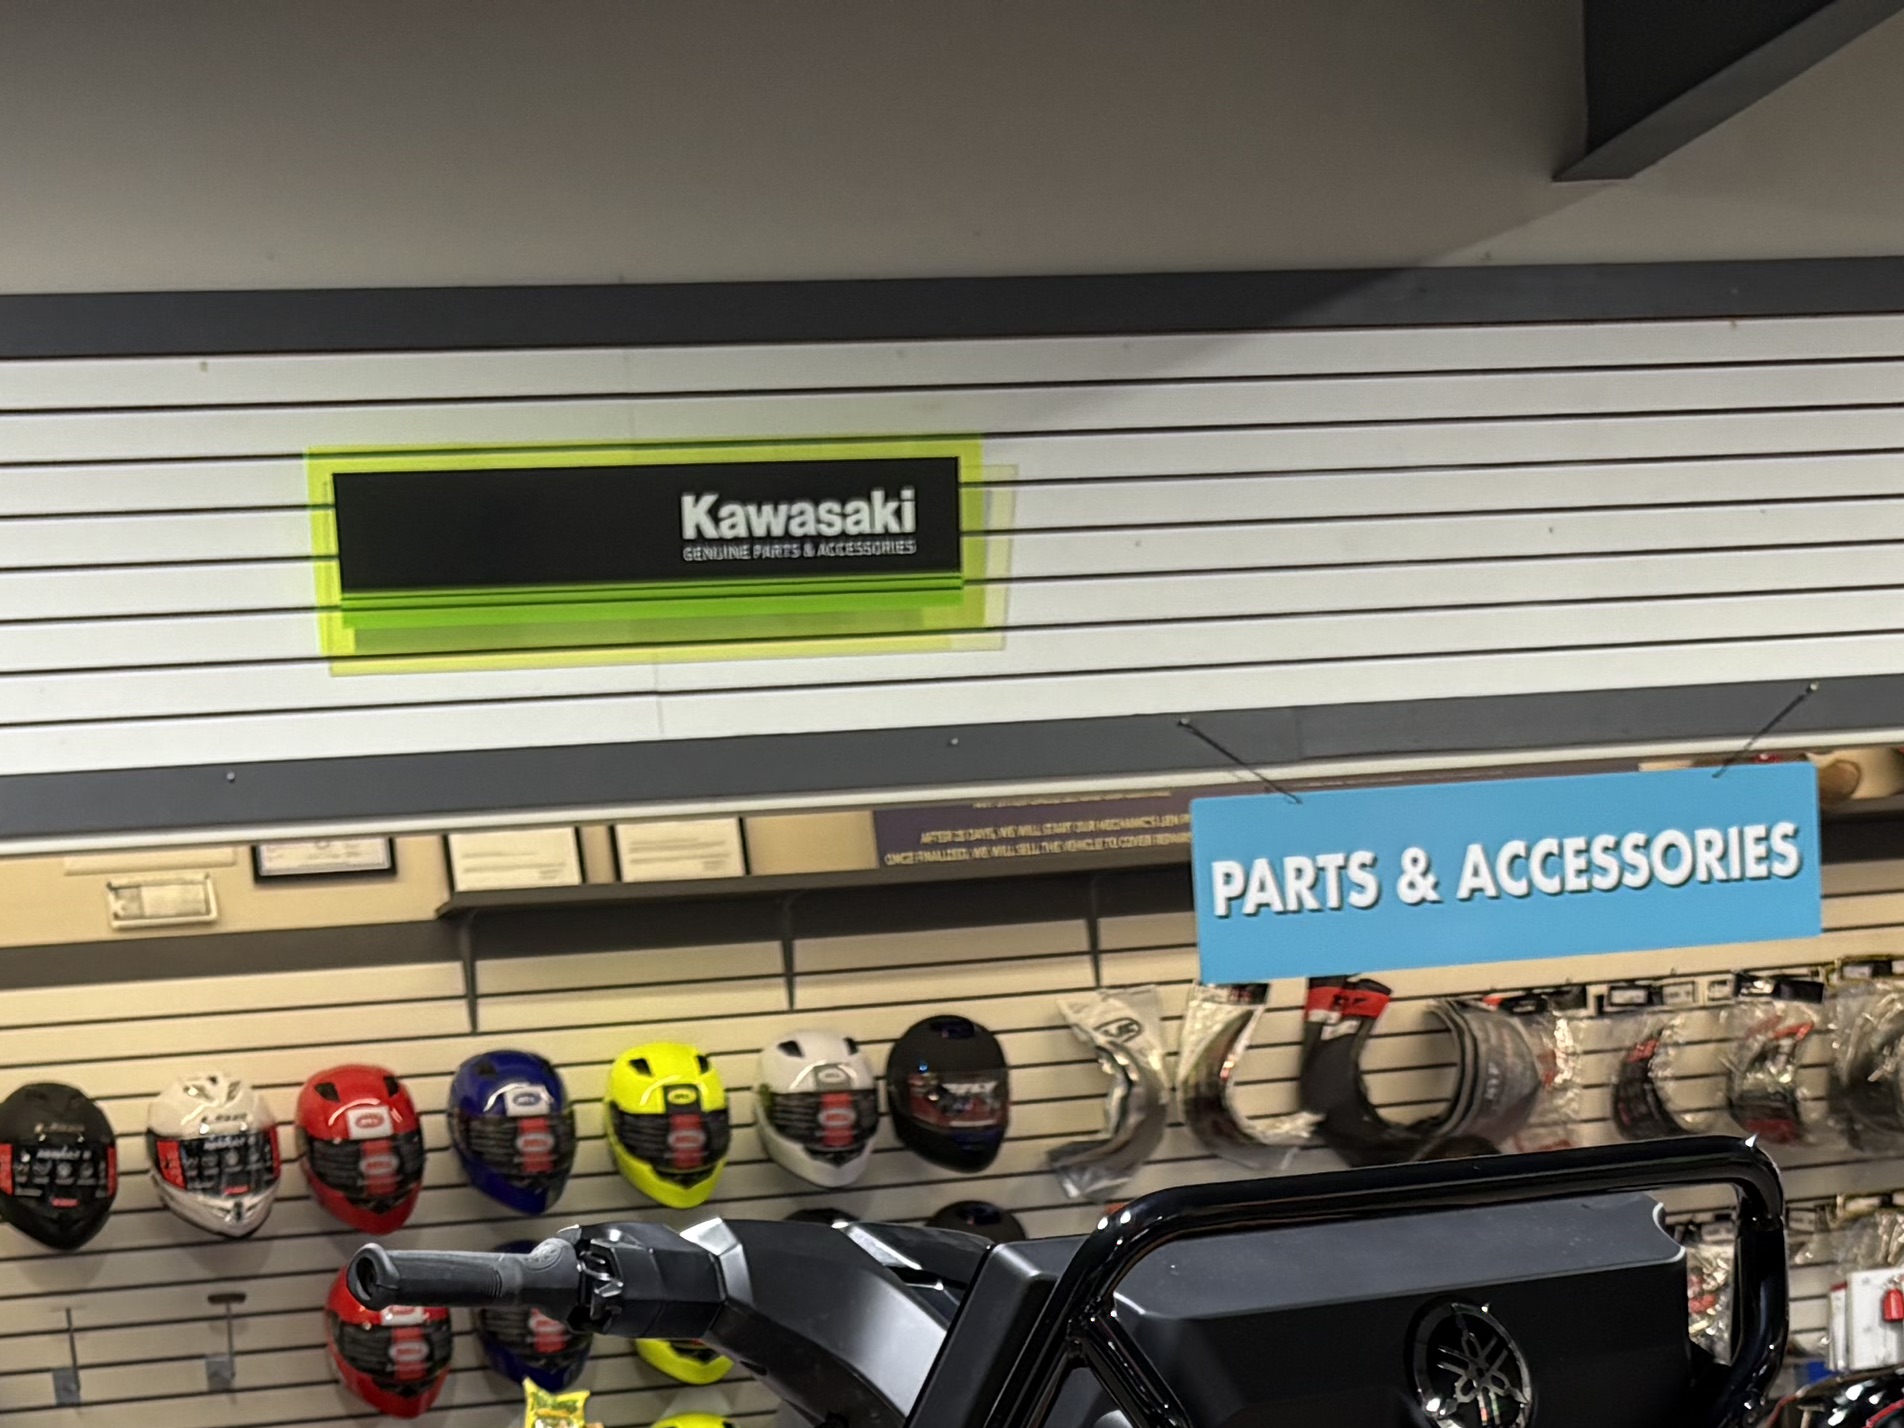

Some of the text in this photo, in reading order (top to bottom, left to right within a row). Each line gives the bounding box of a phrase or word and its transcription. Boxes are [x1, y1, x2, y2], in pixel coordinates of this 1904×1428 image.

[681, 487, 917, 542] Kawasaki
[682, 542, 751, 562] GENUINE
[753, 541, 801, 560] PARTS
[817, 539, 917, 559] ACCESSORIES
[1210, 820, 1802, 919] PARTS & ACCESSORIES
